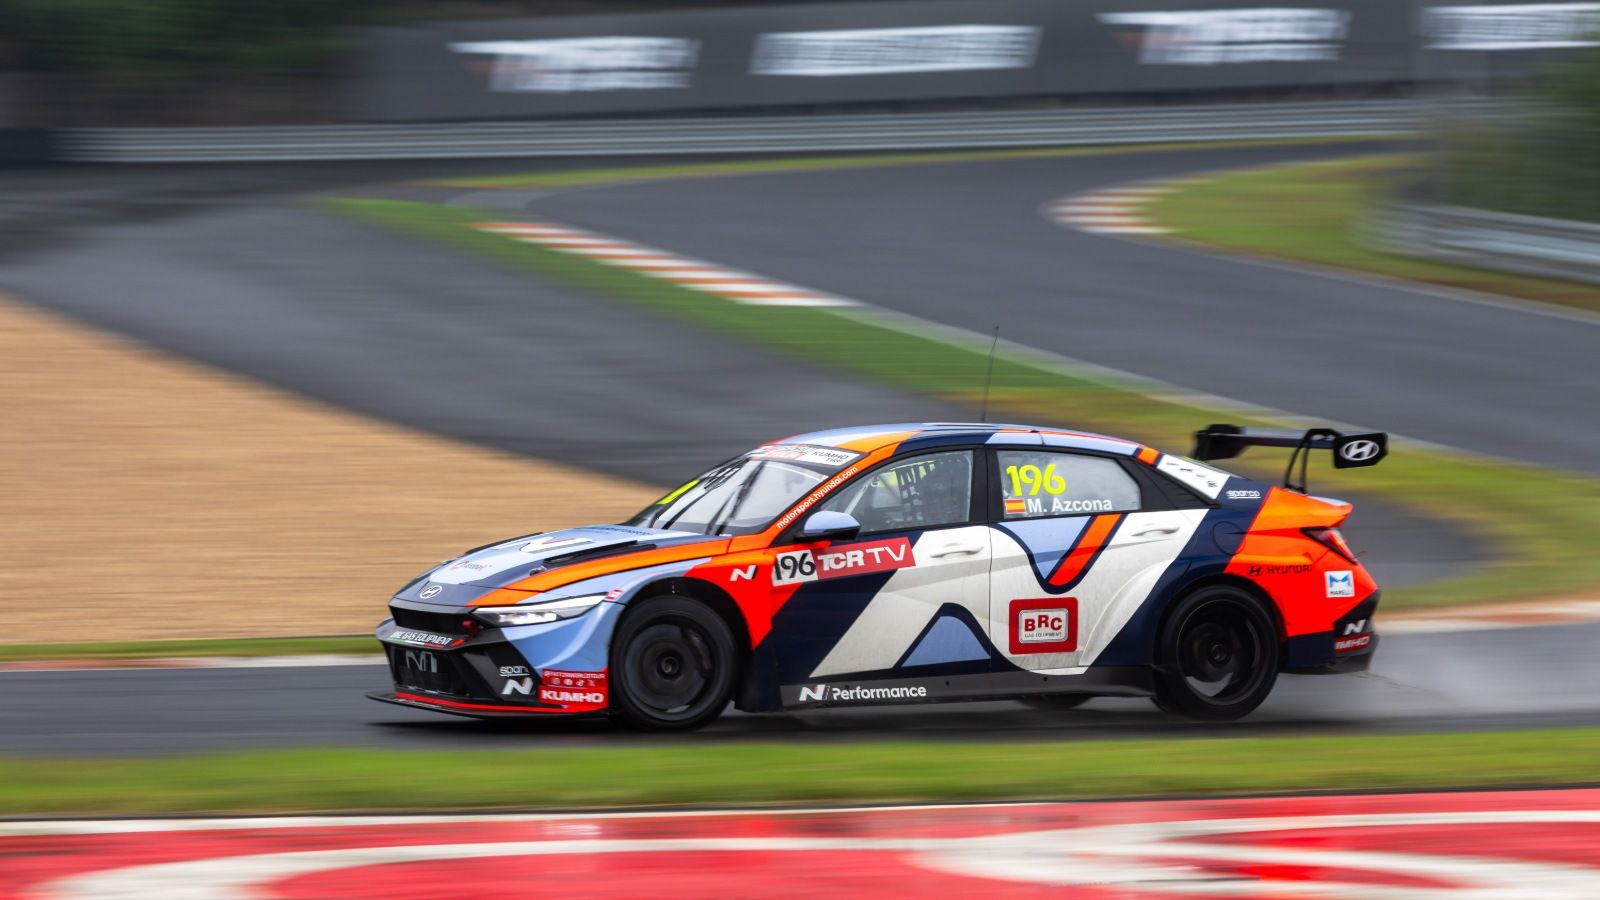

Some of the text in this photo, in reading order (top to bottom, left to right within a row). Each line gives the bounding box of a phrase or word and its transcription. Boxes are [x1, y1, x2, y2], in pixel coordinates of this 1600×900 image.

[1006, 463, 1066, 496] 196
[776, 466, 858, 529] motorsport.hyundai.com
[1027, 498, 1112, 513] M. Azcona
[773, 544, 906, 581] 196 TCR TV
[1024, 615, 1063, 632] BRC
[415, 633, 453, 645] EQUIPMENT
[541, 690, 604, 703] KUMHO
[832, 686, 927, 700] Performance
